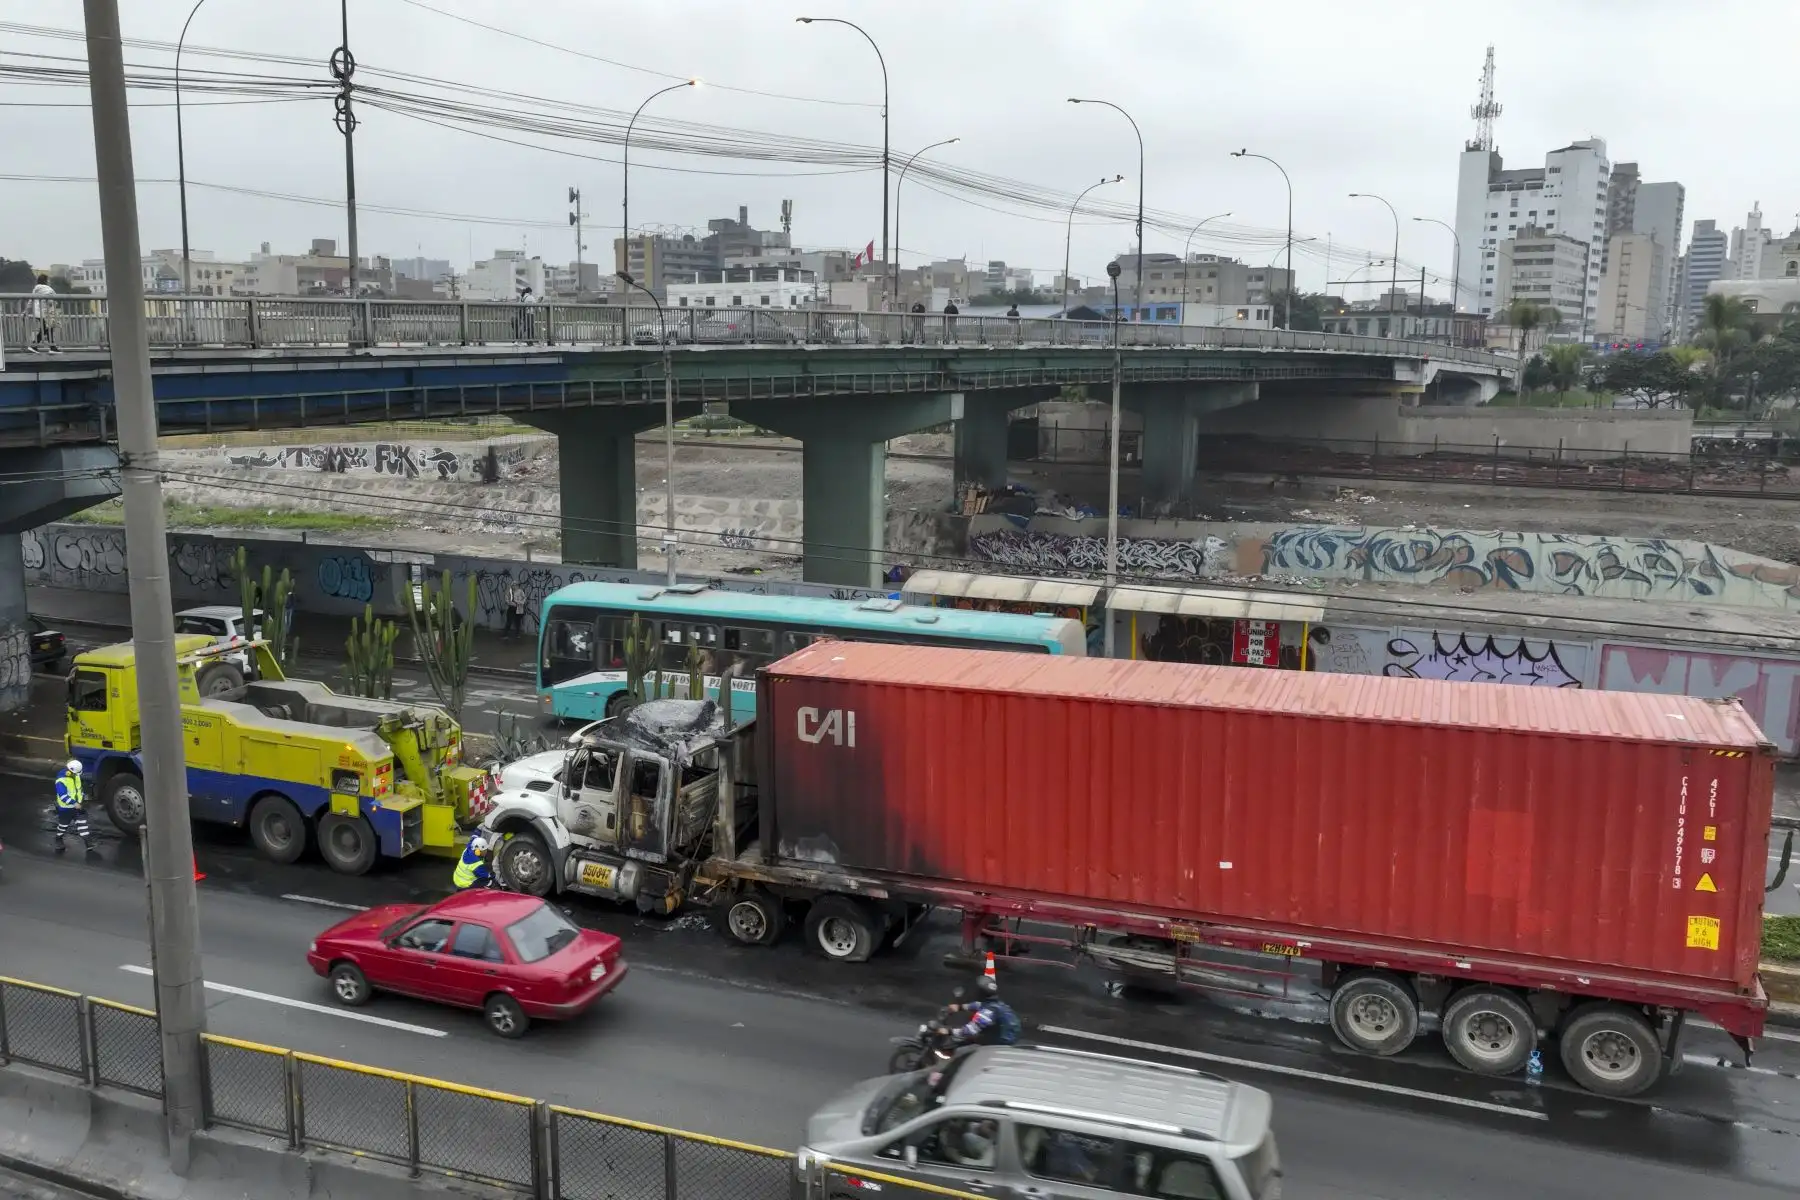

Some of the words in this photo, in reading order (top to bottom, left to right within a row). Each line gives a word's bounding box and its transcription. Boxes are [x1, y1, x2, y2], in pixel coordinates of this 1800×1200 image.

[731, 680, 756, 691] NORT
[797, 706, 856, 748] CAI
[1679, 776, 1689, 815] CAIU
[1674, 818, 1685, 875] 949978
[1689, 917, 1719, 928] CAUTION
[1693, 937, 1712, 948] HIGH
